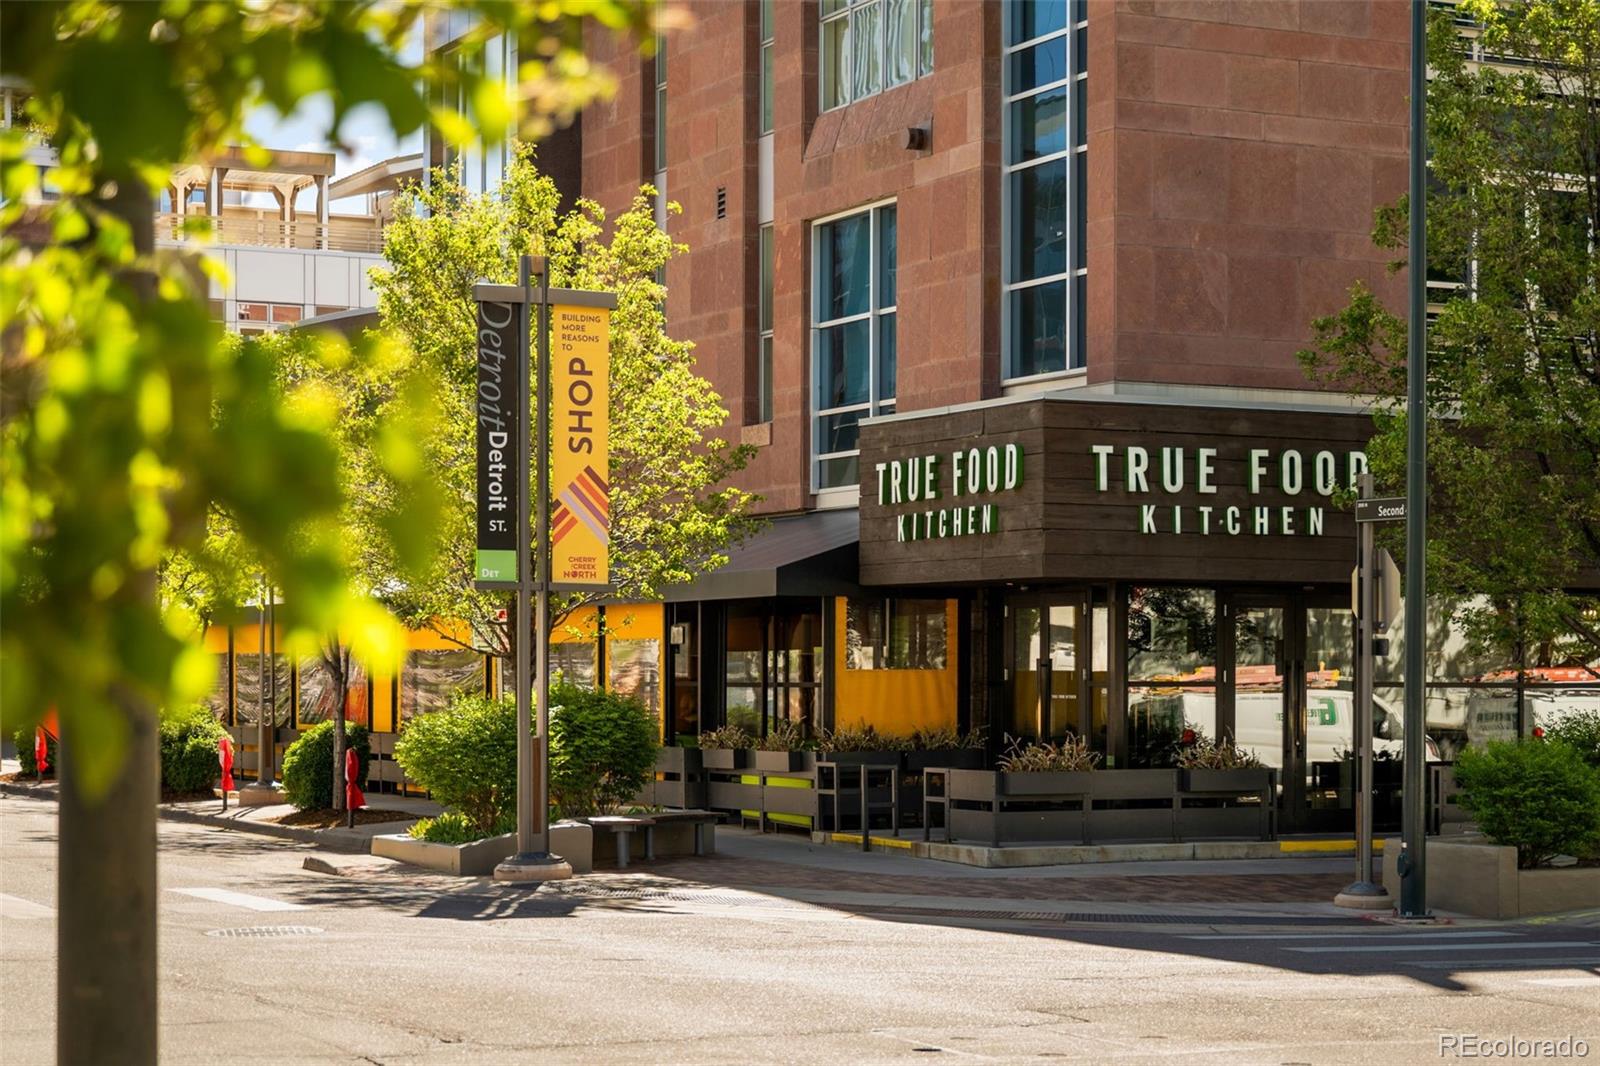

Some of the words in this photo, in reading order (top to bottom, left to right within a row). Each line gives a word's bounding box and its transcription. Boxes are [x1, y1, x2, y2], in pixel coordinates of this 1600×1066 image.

[562, 313, 601, 323] BUILDING
[562, 324, 586, 333] MORE
[562, 334, 600, 343] REASONS
[479, 301, 512, 431] Detroit
[568, 357, 593, 455] SHOP
[488, 431, 508, 511] Detroit
[875, 454, 939, 506] TRUE
[953, 443, 1021, 497] FOOD
[1091, 444, 1218, 495] TRUE
[1248, 448, 1368, 496] FOOD
[897, 503, 994, 543] KITCHEN
[1140, 503, 1324, 536] KITCHEN
[1377, 504, 1405, 517] Second
[563, 570, 597, 578] NORTH
